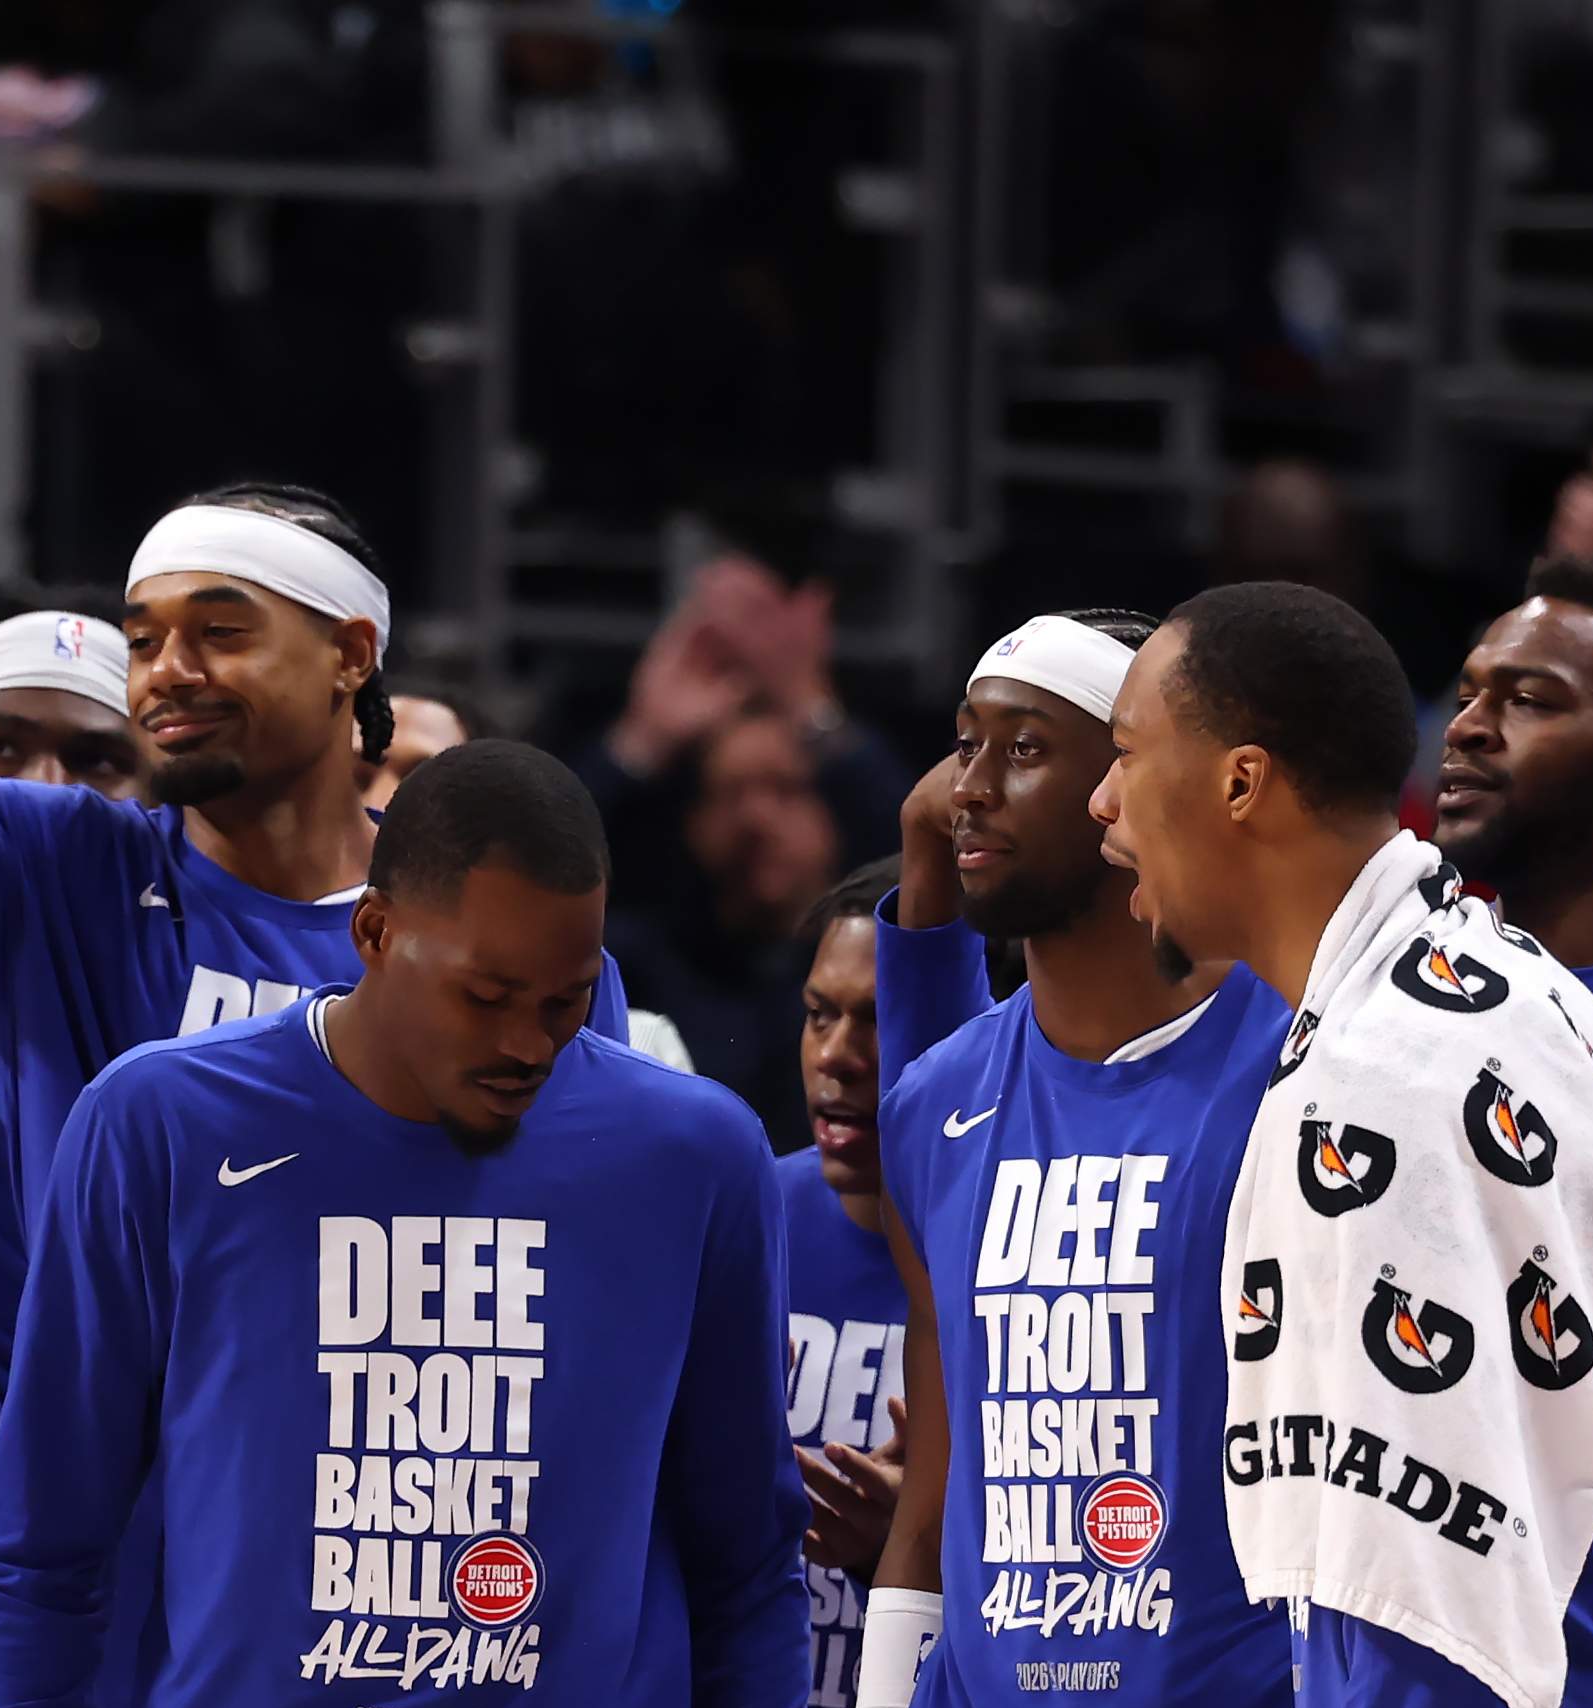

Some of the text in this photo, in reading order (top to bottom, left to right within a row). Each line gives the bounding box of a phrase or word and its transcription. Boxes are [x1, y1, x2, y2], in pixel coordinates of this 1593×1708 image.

[974, 1154, 1169, 1289] DEEE
[318, 1216, 547, 1350] DEEE
[974, 1291, 1155, 1394] TROIT
[317, 1352, 544, 1454] TROIT
[981, 1398, 1158, 1478] BASKET
[314, 1453, 540, 1536] BASKET
[982, 1484, 1082, 1563] BALL
[1096, 1506, 1152, 1523] DETROIT
[1097, 1522, 1153, 1540] PISTONS
[311, 1534, 450, 1619] BALL
[465, 1580, 524, 1597] PISTONS
[467, 1564, 523, 1580] DETROIT
[1016, 1661, 1121, 1691] 2026 PLAYOFFS
